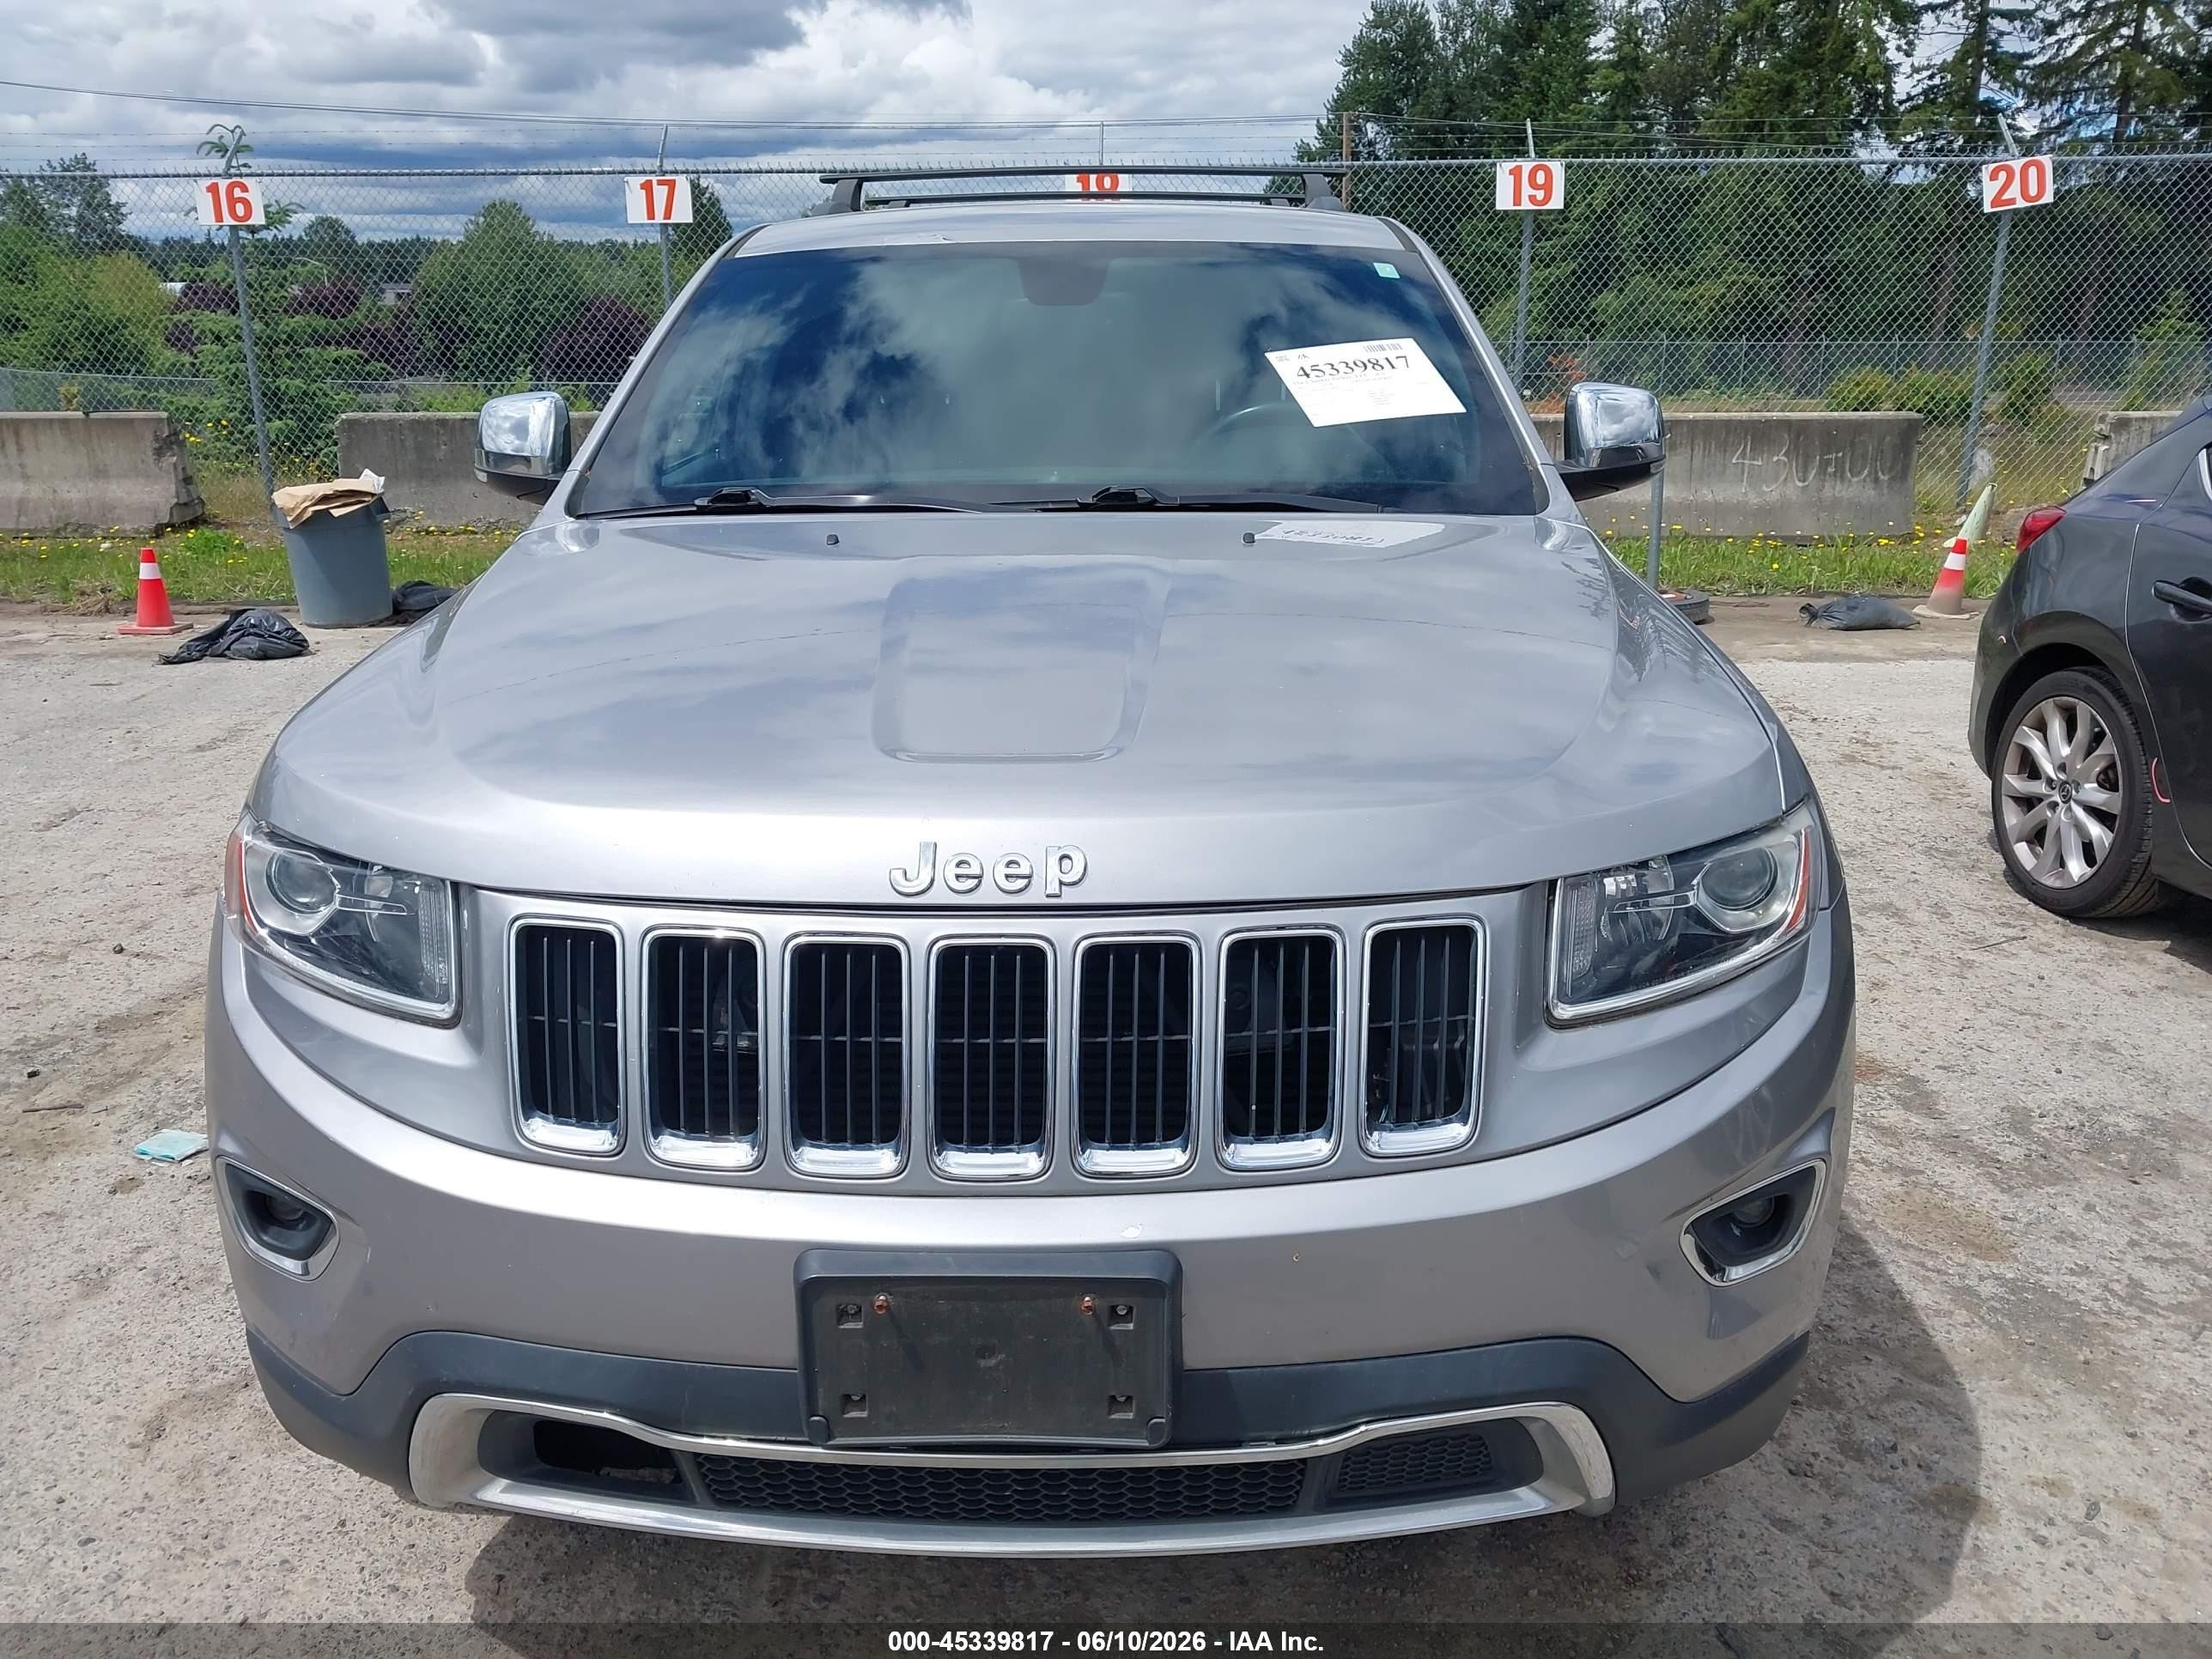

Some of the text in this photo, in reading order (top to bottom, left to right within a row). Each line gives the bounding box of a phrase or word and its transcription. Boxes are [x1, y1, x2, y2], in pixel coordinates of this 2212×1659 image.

[205, 180, 253, 223] 16
[639, 179, 677, 221] 17
[1509, 163, 1553, 207] 19
[1989, 159, 2047, 209] 20
[1297, 356, 1410, 379] 45339817
[889, 842, 1088, 898] Jeep
